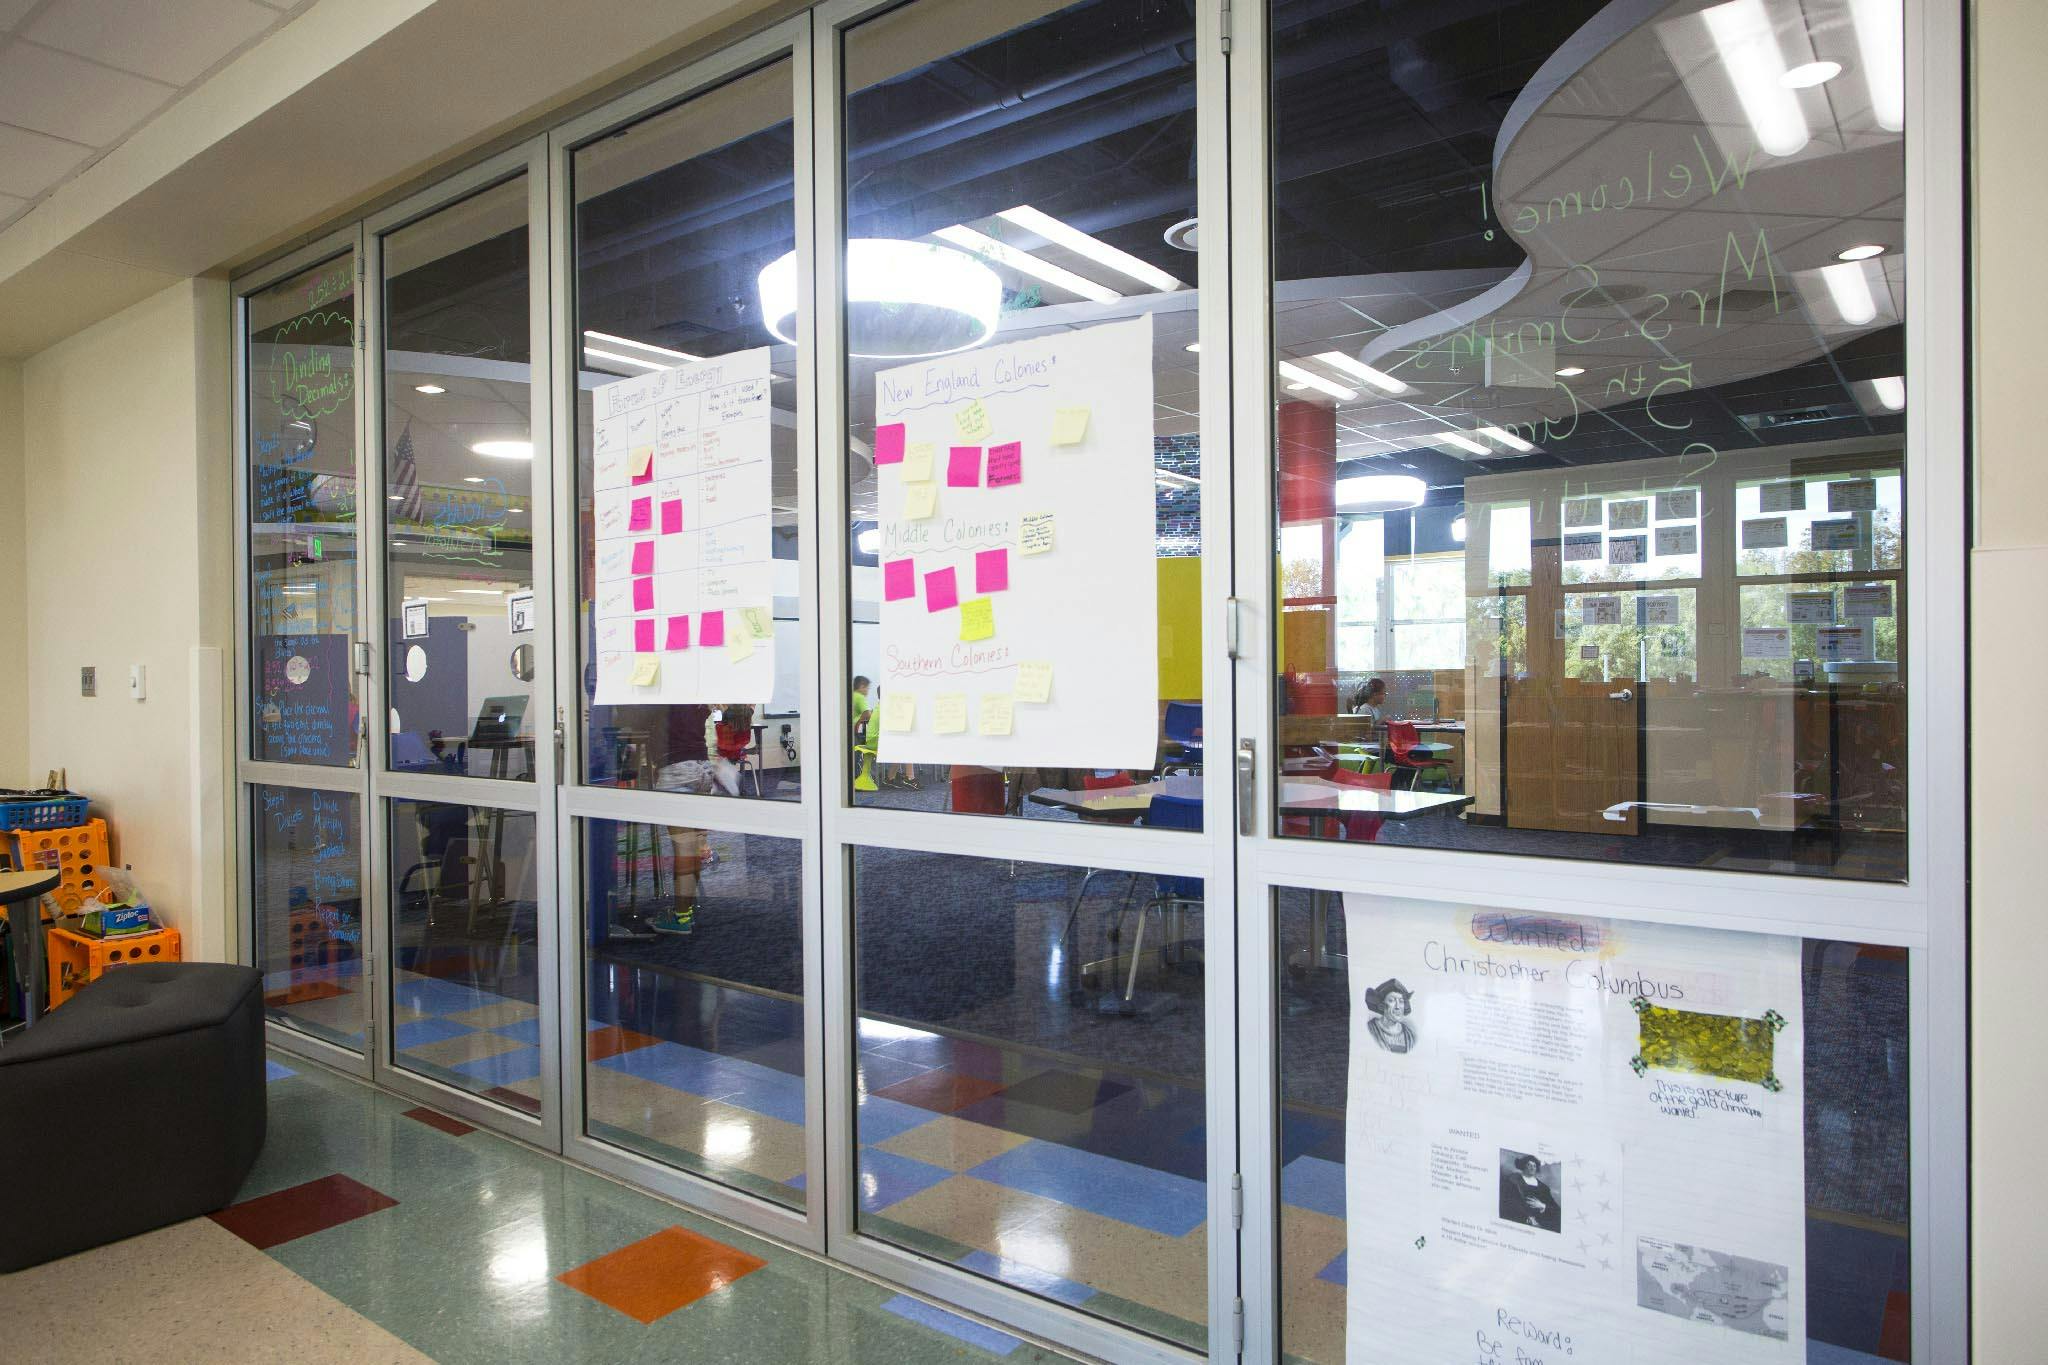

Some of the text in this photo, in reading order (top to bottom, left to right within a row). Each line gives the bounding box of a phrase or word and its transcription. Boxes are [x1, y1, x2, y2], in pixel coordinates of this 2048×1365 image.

[283, 346, 331, 391] Dividing
[674, 366, 724, 391] Energy
[882, 379, 913, 406] New
[924, 367, 981, 404] England
[885, 522, 930, 549] Middle
[944, 518, 1009, 543] Colonies:
[886, 644, 943, 673] Southern
[116, 910, 139, 923] Ziploc
[1424, 941, 1684, 999] Christopher Columbus
[1688, 1096, 1718, 1111] gold
[1448, 1127, 1480, 1140] WANTED
[1476, 1328, 1503, 1357] Be
[1497, 1307, 1573, 1355] Reward:
